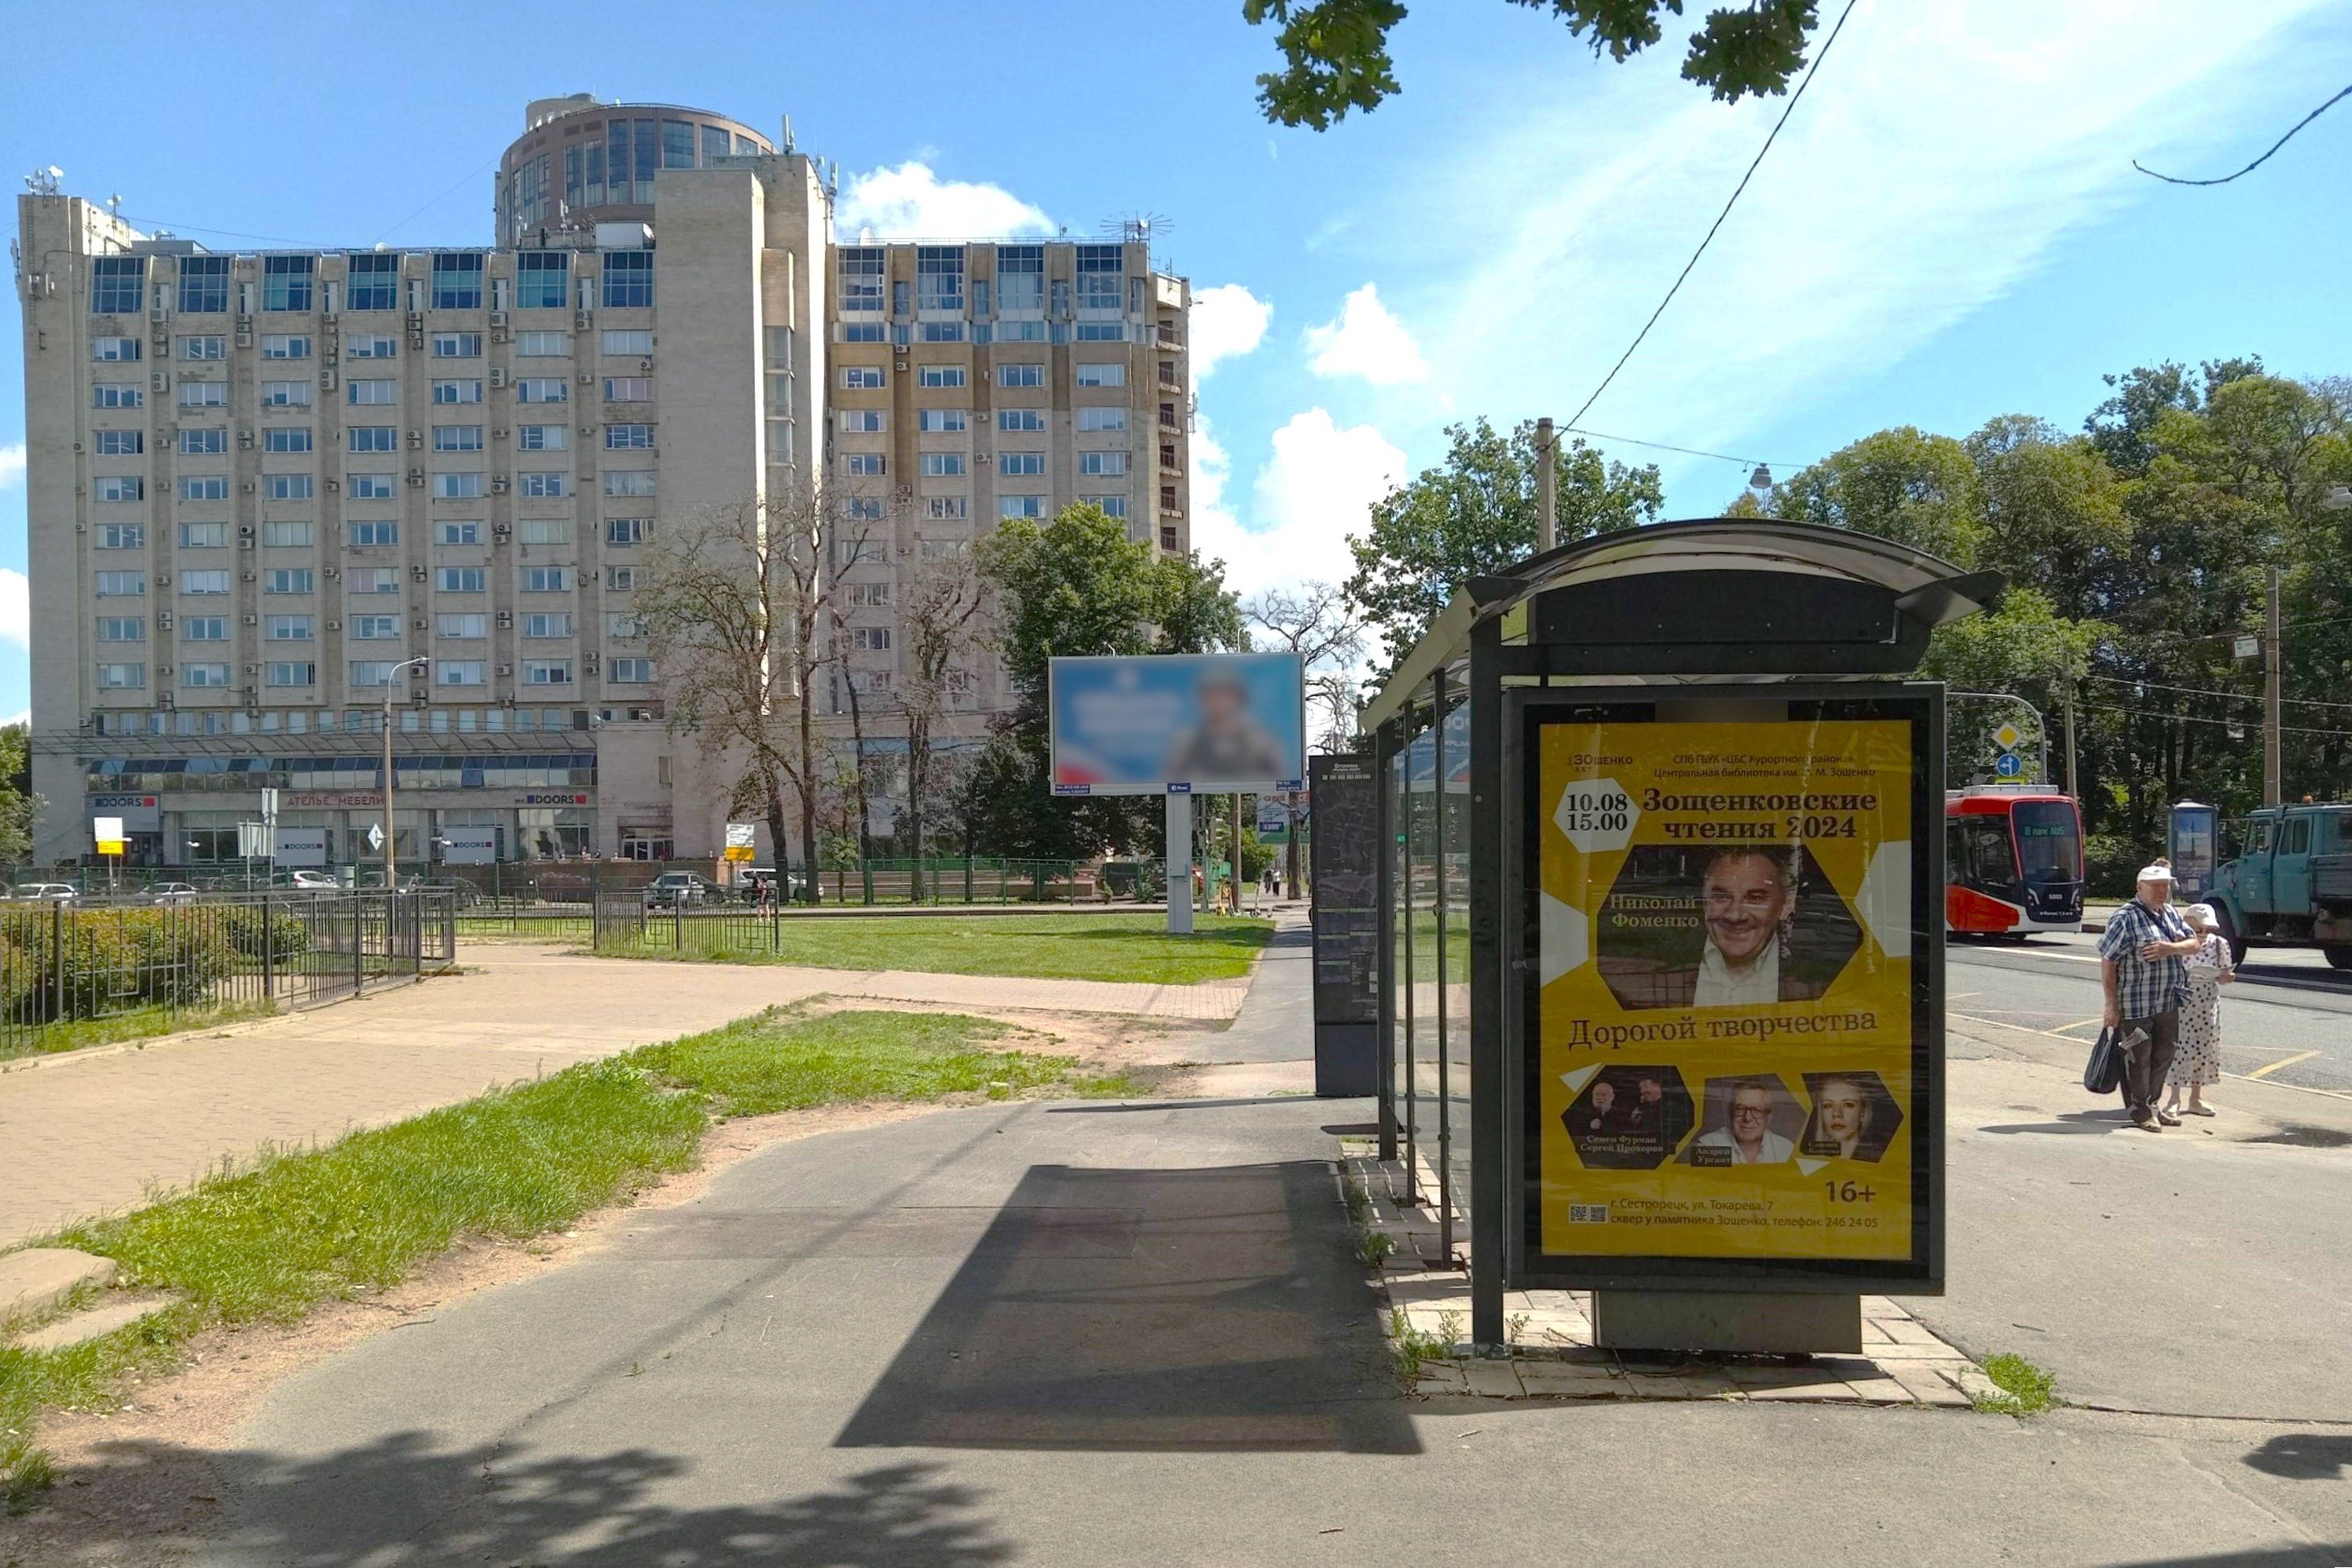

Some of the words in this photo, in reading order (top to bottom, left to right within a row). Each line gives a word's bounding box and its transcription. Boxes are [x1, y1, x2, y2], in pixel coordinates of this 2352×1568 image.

[1654, 768, 1719, 779] Центральная
[1722, 768, 1780, 778] библиотека
[1830, 768, 1876, 779] Зощенко
[288, 796, 330, 806] АТЕЛЬЕ
[338, 795, 385, 806] МЕБЕЛИ
[535, 795, 574, 804] DOORS
[1567, 793, 1628, 811] 10.08
[1643, 787, 1878, 815] Зощенковские
[1567, 813, 1628, 831] 15.00
[1662, 822, 1778, 839] чтения
[1786, 815, 1857, 839] 2024
[1610, 894, 1696, 910] Николай
[1611, 913, 1700, 927] Фоменко
[1568, 1016, 1696, 1051] Дорогой
[1705, 1012, 1879, 1042] творчества
[1825, 1180, 1877, 1203] 16+
[1768, 1200, 1774, 1211] 7
[1610, 1214, 1643, 1226] сквер
[1654, 1216, 1714, 1225] памятника
[1773, 1216, 1823, 1230] телефон:
[1826, 1217, 1846, 1227] 246
[1848, 1218, 1862, 1227] 24
[1864, 1218, 1878, 1228] 05
